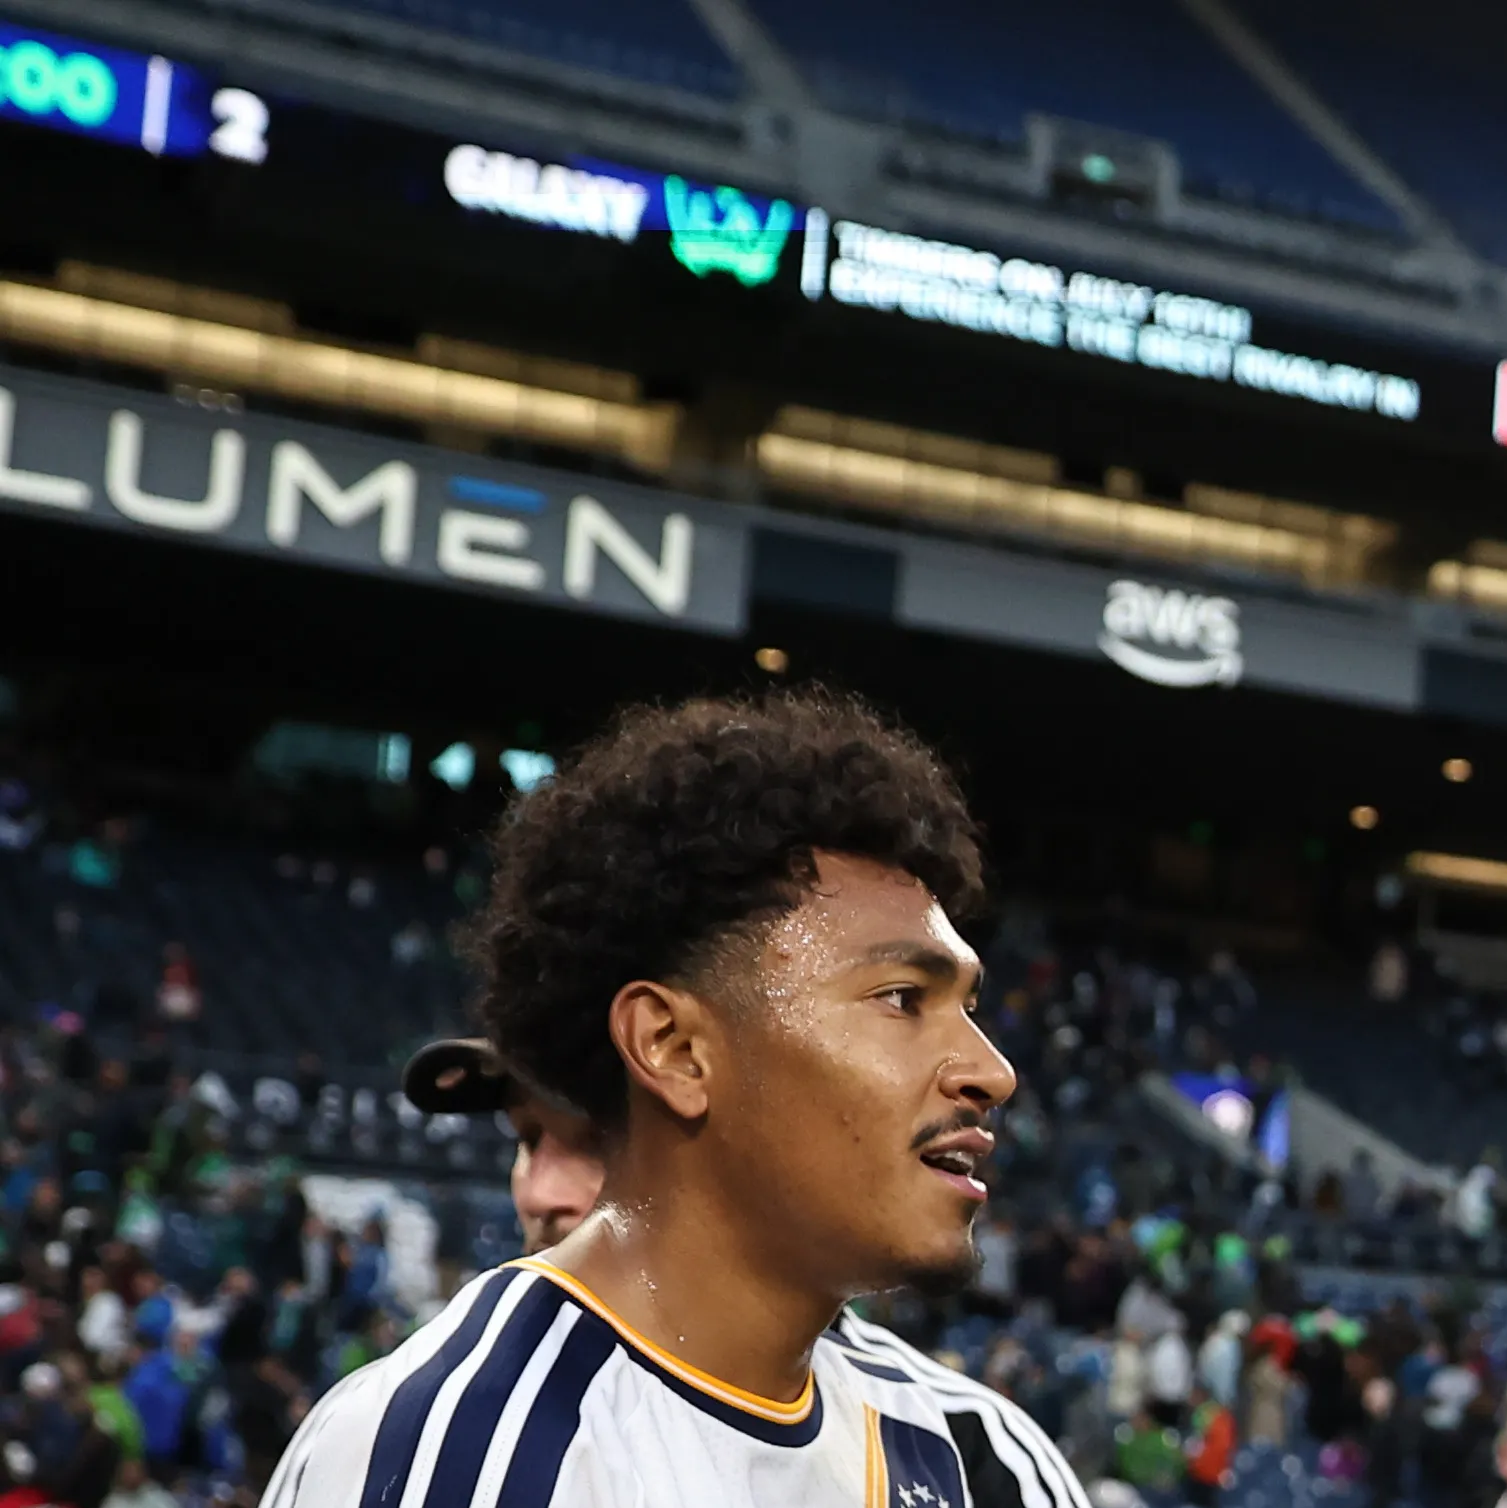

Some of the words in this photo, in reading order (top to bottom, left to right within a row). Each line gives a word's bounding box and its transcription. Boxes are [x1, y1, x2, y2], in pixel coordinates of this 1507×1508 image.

[0, 39, 118, 128] 00
[208, 87, 270, 165] 2
[0, 385, 693, 617] LUMEN
[1103, 579, 1241, 660] aws
